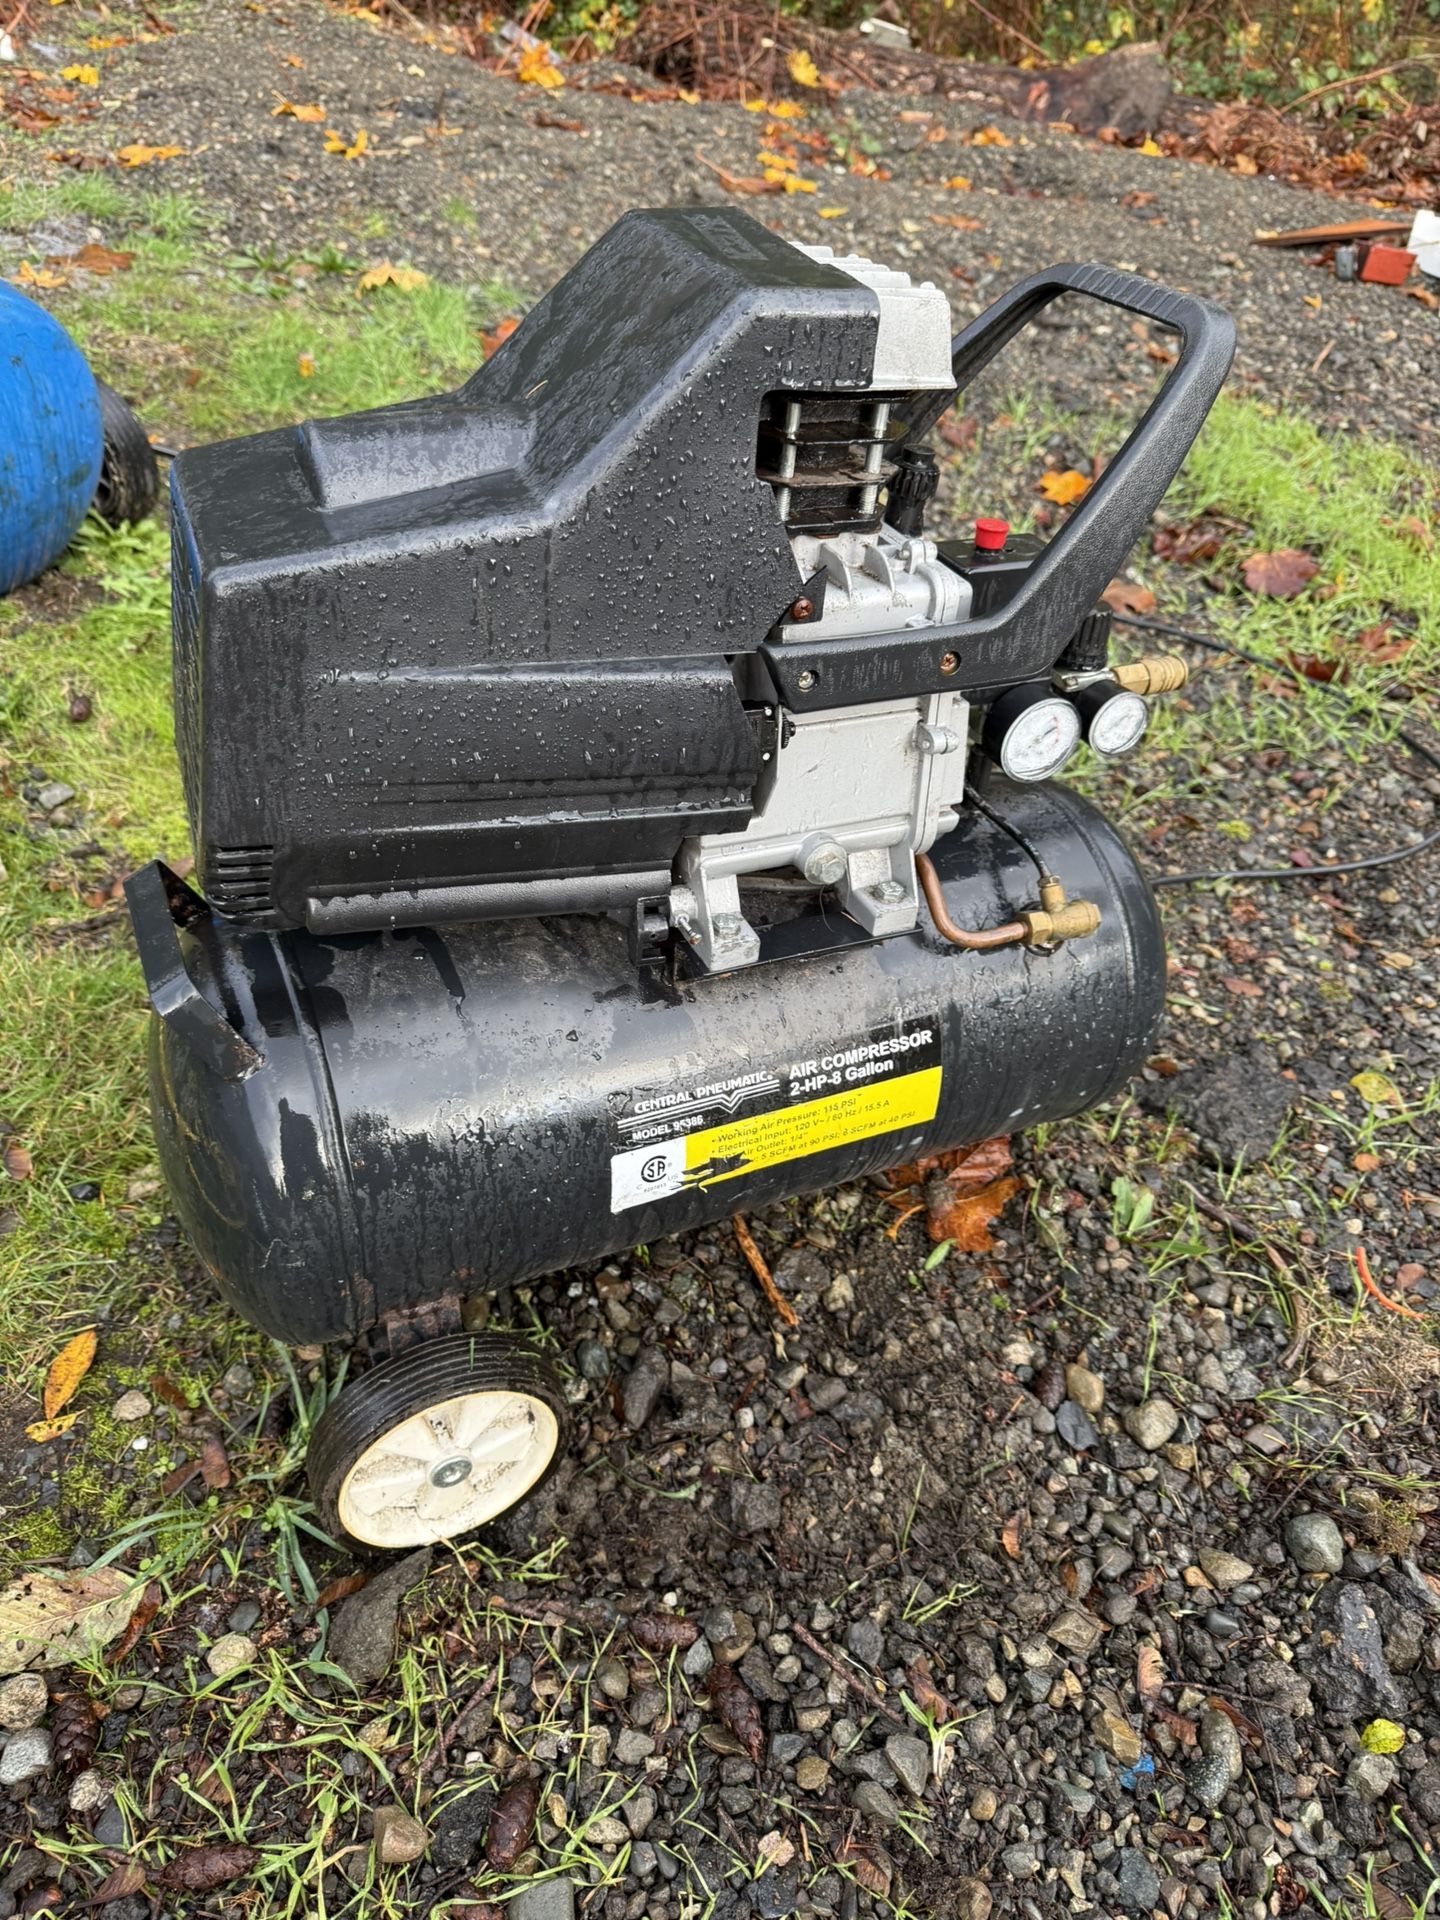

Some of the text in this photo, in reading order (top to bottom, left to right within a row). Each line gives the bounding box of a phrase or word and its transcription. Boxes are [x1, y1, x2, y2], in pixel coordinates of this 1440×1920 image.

[789, 1029, 933, 1080] AIR COMPRESSOR
[790, 1059, 894, 1096] 2-HP-8 Gallon
[634, 1091, 693, 1114] CENTRAL
[718, 1098, 856, 1142] Working Air Pressure: 115 PSI
[632, 1124, 672, 1140] MODEL
[718, 1135, 762, 1153] Electrical
[765, 1128, 791, 1139] Input:
[795, 1121, 810, 1131] 120
[832, 1112, 843, 1121] 60
[845, 1109, 857, 1118] Hz
[756, 1139, 787, 1153] Outlet:
[769, 1144, 796, 1158] SCFM
[809, 1137, 820, 1146] 90
[850, 1122, 876, 1134] SCFM
[901, 1111, 915, 1120] PSI
